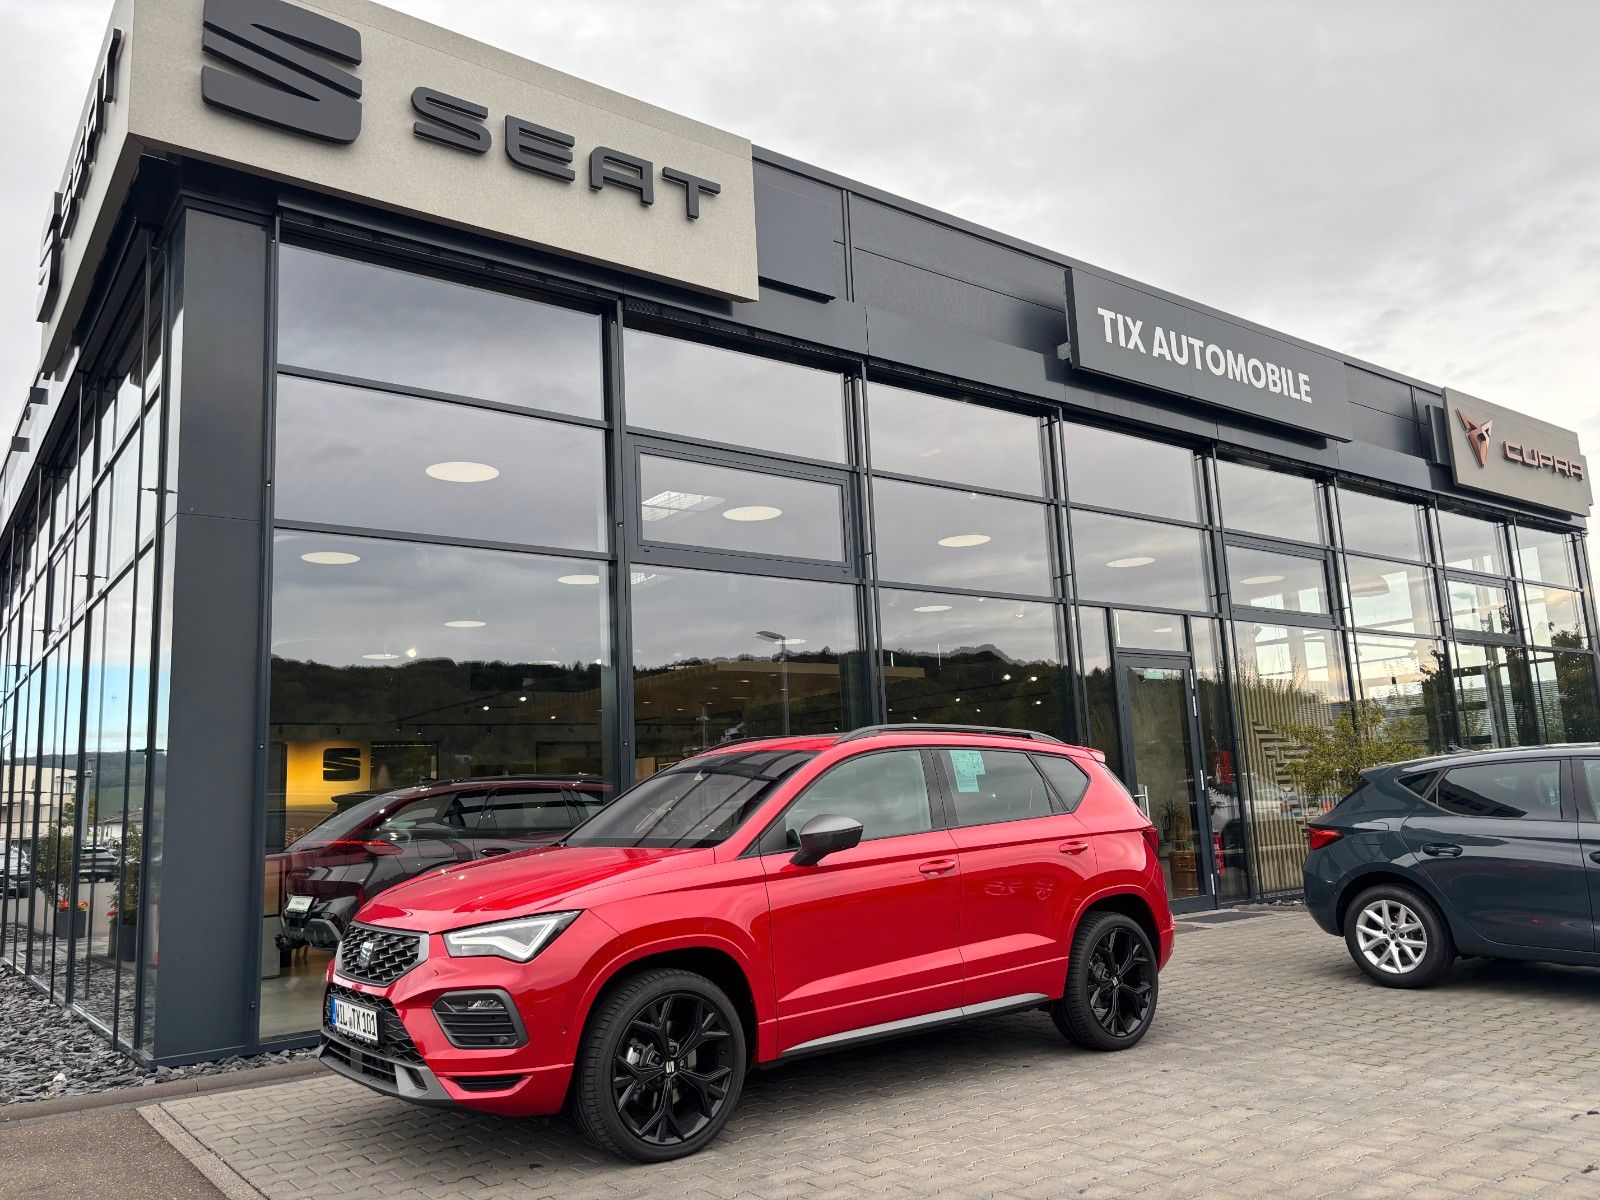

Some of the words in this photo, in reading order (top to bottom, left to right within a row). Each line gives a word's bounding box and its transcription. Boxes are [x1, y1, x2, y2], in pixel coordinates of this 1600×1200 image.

[411, 86, 721, 219] SEAT
[1097, 307, 1146, 354] TIX
[1152, 326, 1312, 404] AUTOMOBILE
[1503, 440, 1584, 481] CUPRA
